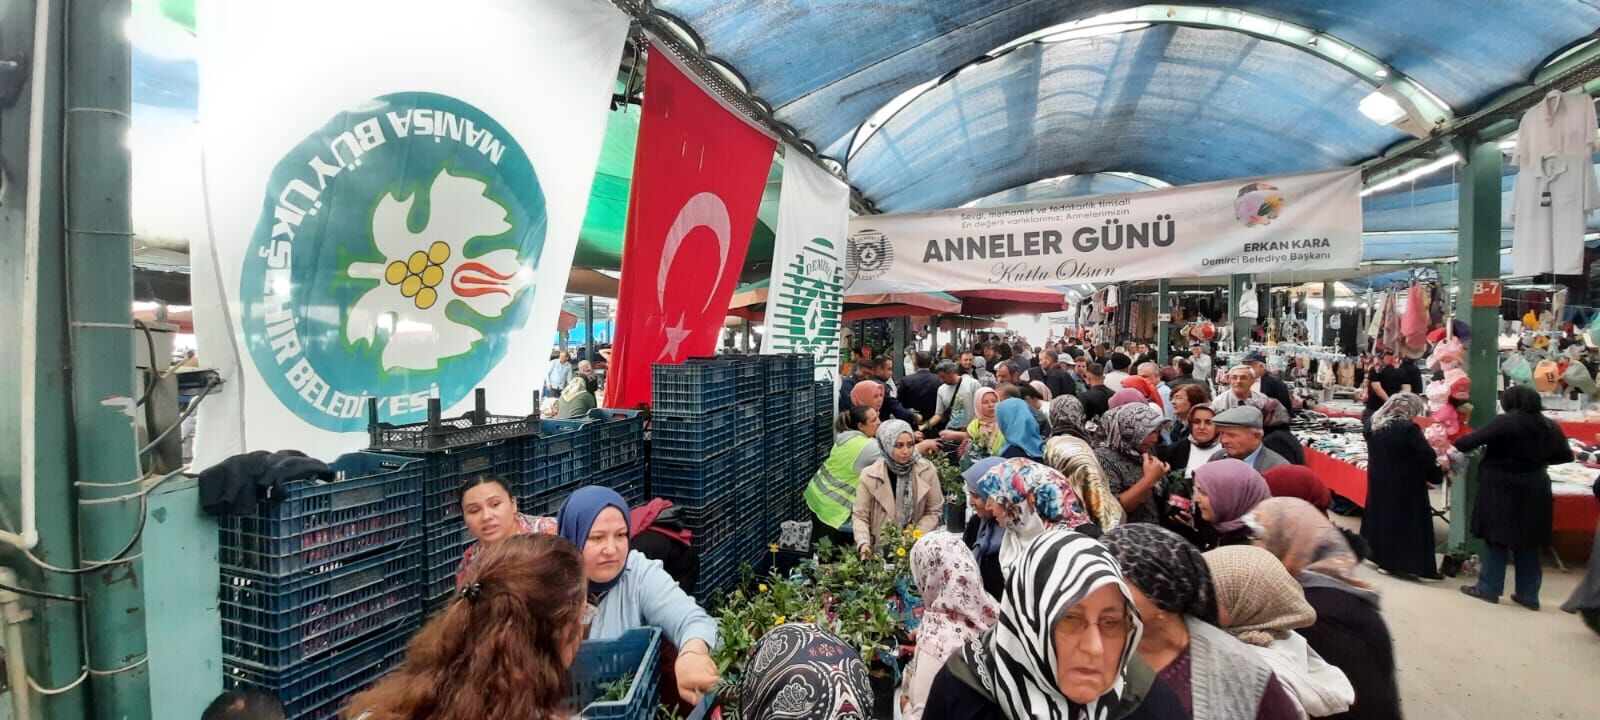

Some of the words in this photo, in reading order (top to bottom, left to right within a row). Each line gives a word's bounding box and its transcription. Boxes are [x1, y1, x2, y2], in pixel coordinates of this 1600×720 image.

[386, 108, 506, 166] MANİSA
[988, 207, 1034, 218] merhamet
[1036, 206, 1047, 214] ve
[1098, 197, 1131, 208] timsali
[961, 221, 973, 229] En
[1065, 208, 1130, 221] Annelerimizin
[922, 230, 1063, 263] ANNELER
[1072, 213, 1176, 252] GÜNÜ
[1243, 241, 1290, 253] ERKAN
[1292, 237, 1331, 249] KARA
[1201, 255, 1240, 267] Demirci
[1242, 253, 1288, 265] Belediye
[1289, 251, 1331, 262] Başkanı
[988, 261, 1049, 284] Kutlu
[1055, 258, 1115, 281] Olsun
[1473, 281, 1500, 295] B-7
